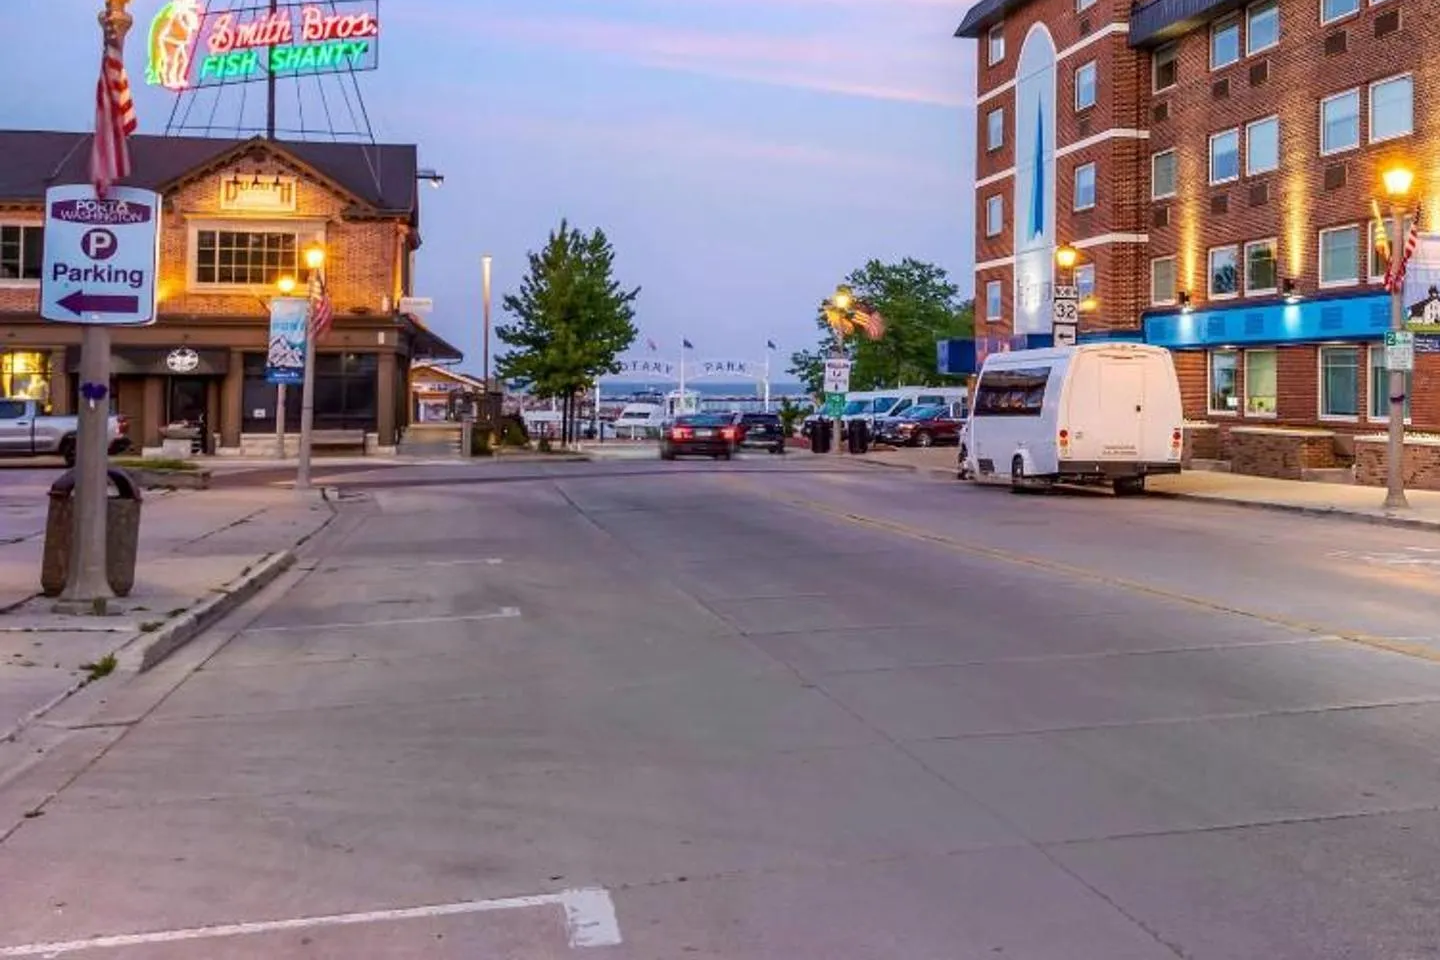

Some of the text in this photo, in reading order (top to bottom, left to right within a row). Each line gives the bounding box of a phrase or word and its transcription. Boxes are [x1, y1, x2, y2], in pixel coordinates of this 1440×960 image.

[207, 4, 378, 53] Smith Bros.
[201, 41, 368, 80] FISH SHANTY
[60, 209, 143, 221] WASHINGTON
[89, 231, 113, 257] P
[52, 262, 144, 288] Parking
[1056, 304, 1076, 319] 32
[618, 360, 747, 374] OTARY PARK
